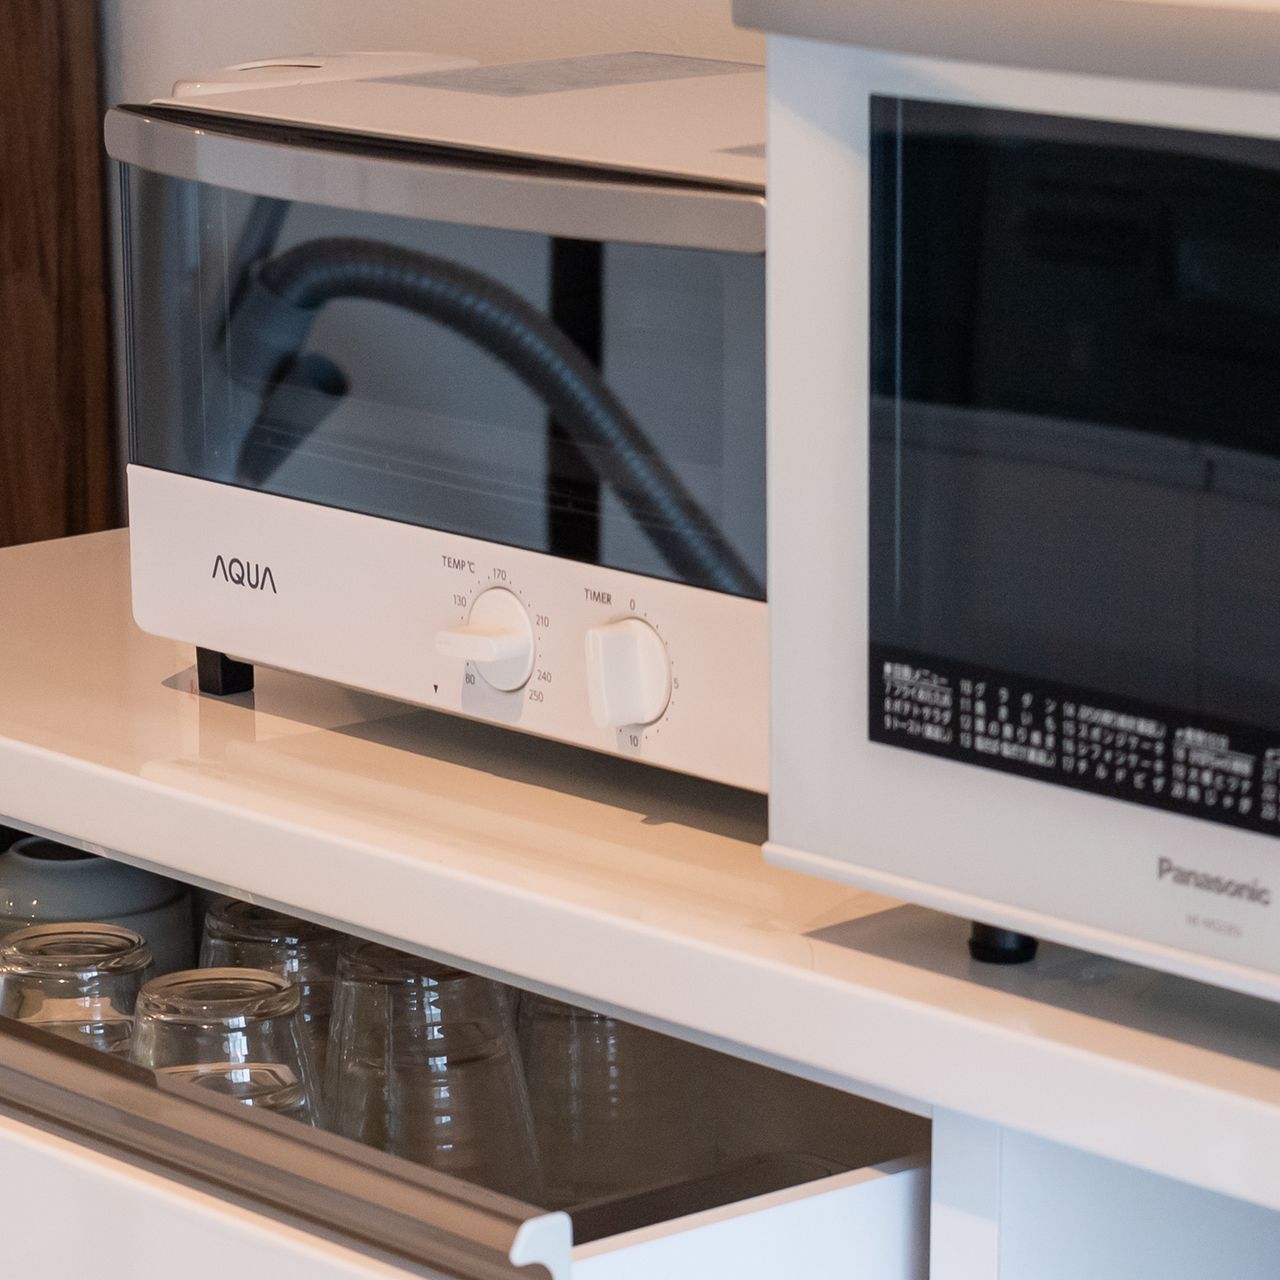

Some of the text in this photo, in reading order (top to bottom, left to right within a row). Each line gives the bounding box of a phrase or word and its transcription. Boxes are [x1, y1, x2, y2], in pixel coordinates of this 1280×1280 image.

[212, 554, 277, 594] AQUA
[492, 567, 507, 581] 170
[453, 594, 467, 607] 130
[584, 587, 612, 606] TIMER
[629, 598, 636, 611] 0
[535, 614, 550, 628] 210
[537, 669, 552, 683] 240
[673, 677, 680, 690] 5
[528, 689, 544, 703] 250
[629, 734, 639, 748] 10
[1158, 856, 1272, 907] Panasonic
